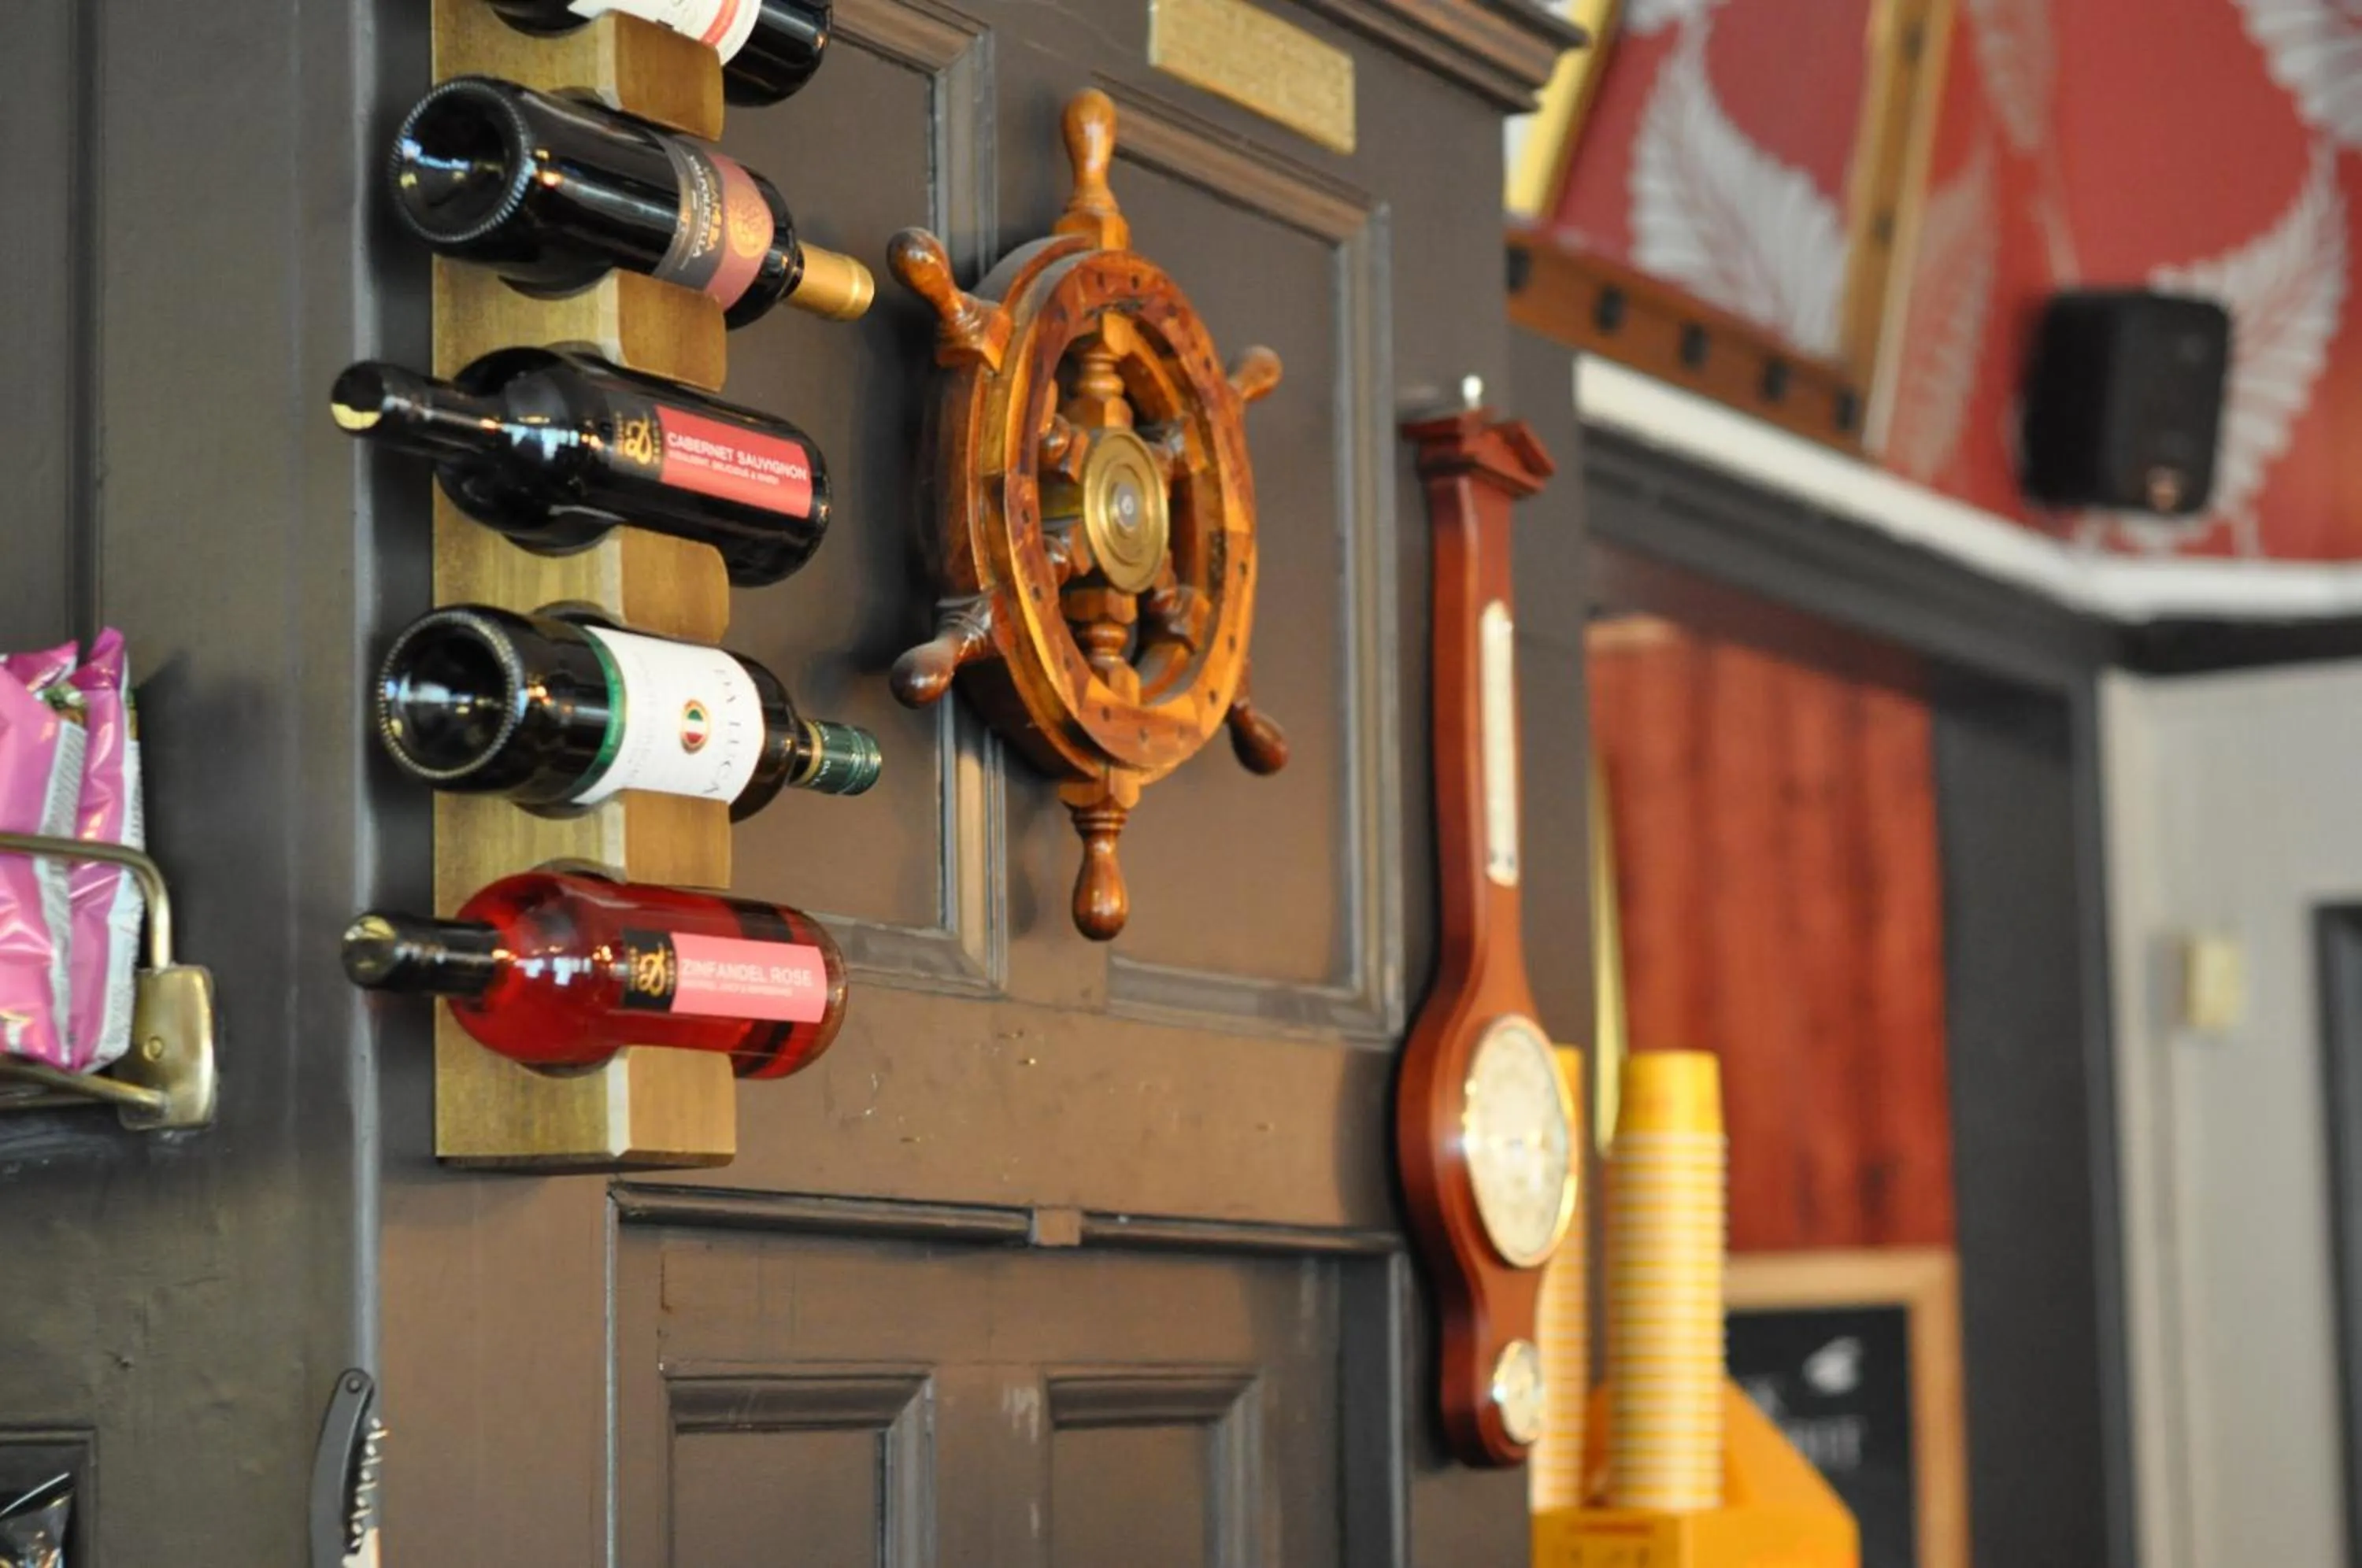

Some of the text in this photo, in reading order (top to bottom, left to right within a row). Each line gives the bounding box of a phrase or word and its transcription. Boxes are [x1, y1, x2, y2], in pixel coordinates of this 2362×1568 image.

[668, 431, 734, 461] CABERNET
[737, 450, 807, 479] SAUVIGNON
[681, 957, 766, 983] ZINFANDEL
